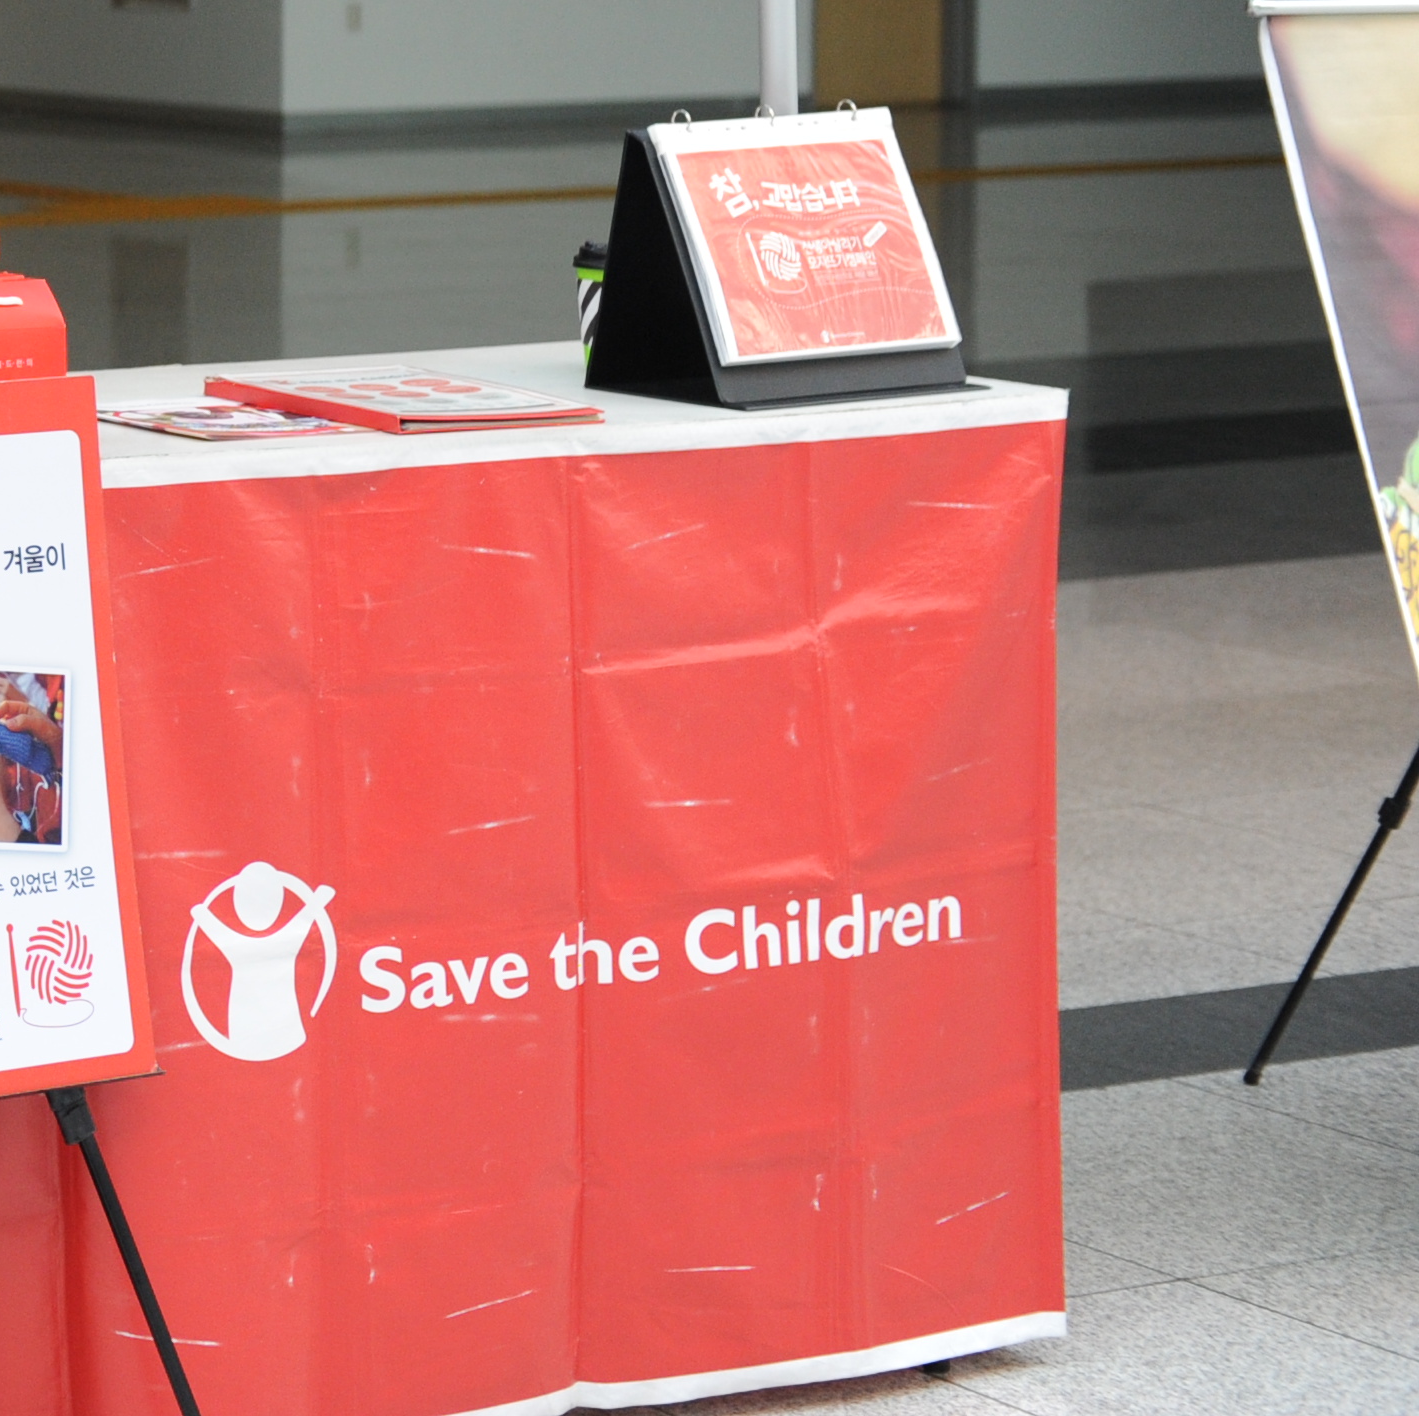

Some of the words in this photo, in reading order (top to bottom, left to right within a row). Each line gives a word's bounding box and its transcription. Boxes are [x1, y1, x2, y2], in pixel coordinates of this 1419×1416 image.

[761, 178, 861, 213] 고맙습니다
[3, 542, 67, 573] 겨울이
[10, 871, 59, 897] 있었던
[63, 865, 96, 891] 것은
[361, 945, 529, 1015] Save
[549, 921, 660, 991] the
[684, 893, 962, 976] Children
